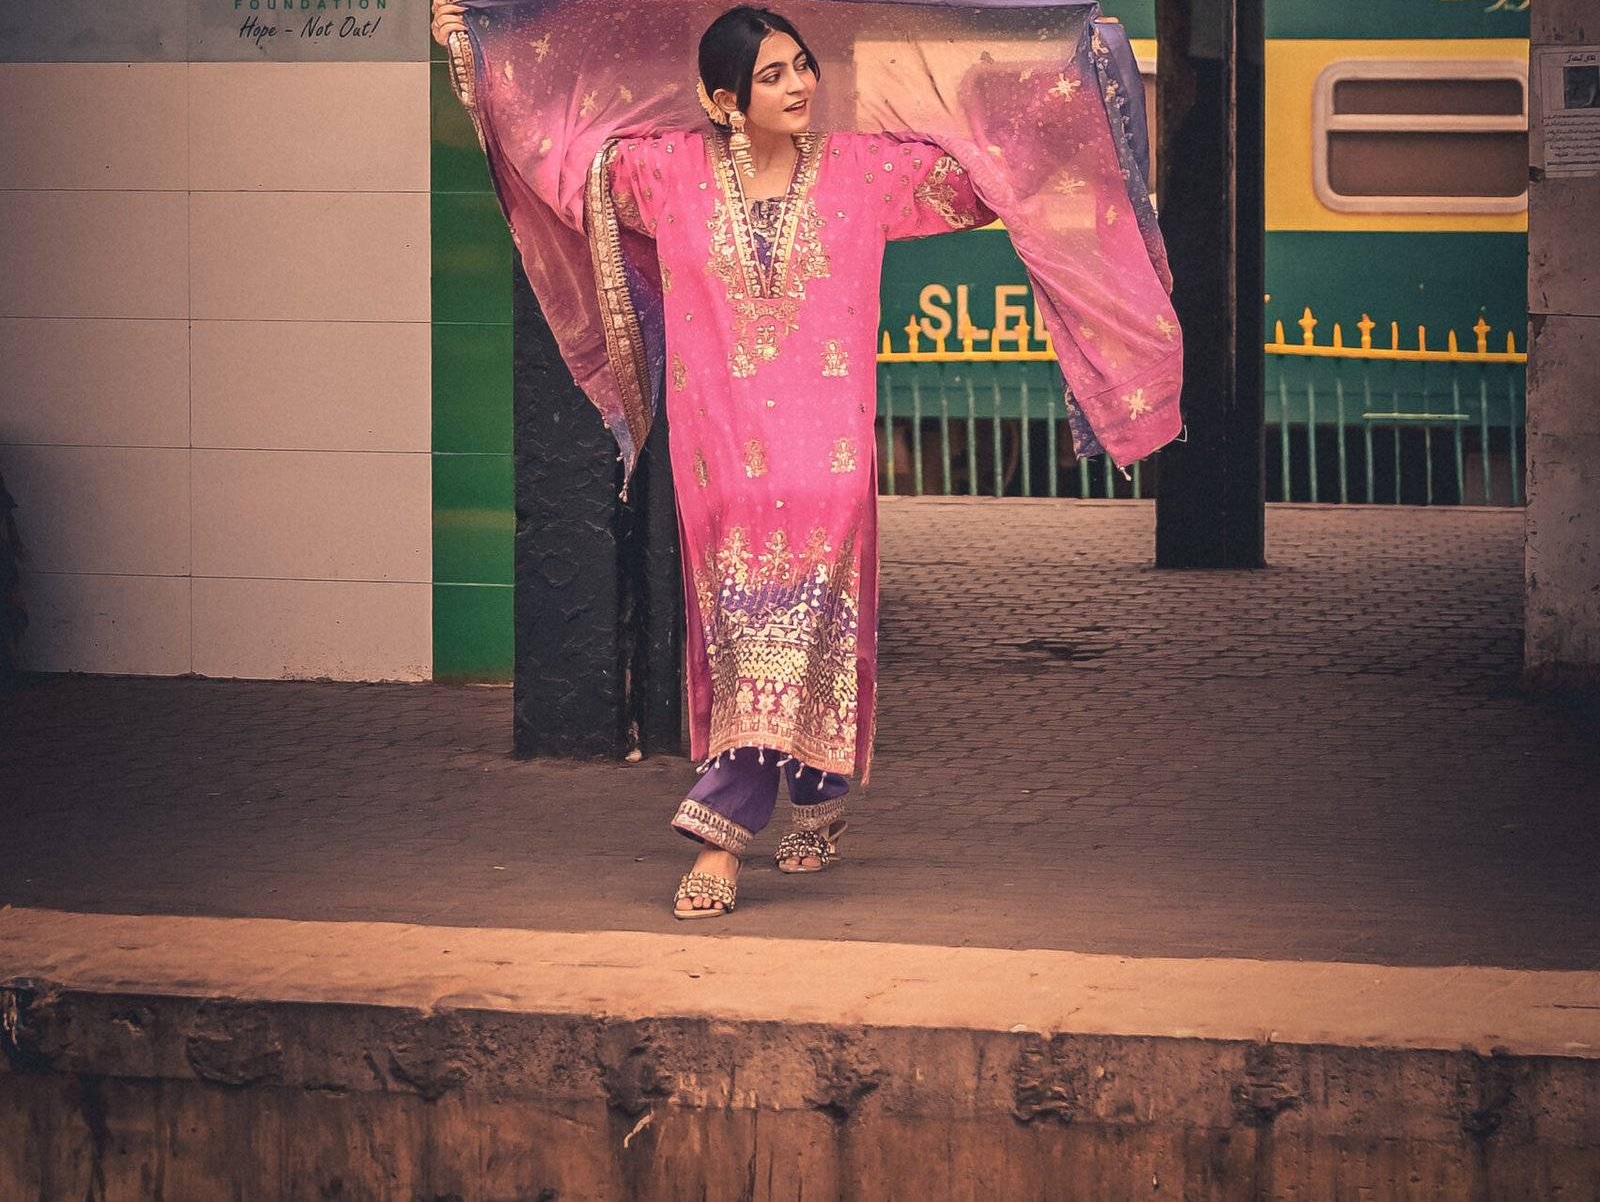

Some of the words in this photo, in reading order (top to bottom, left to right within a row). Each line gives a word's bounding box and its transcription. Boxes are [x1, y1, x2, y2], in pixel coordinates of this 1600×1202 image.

[238, 15, 278, 45] Hope
[299, 15, 335, 39] Not
[338, 15, 382, 39] Out!
